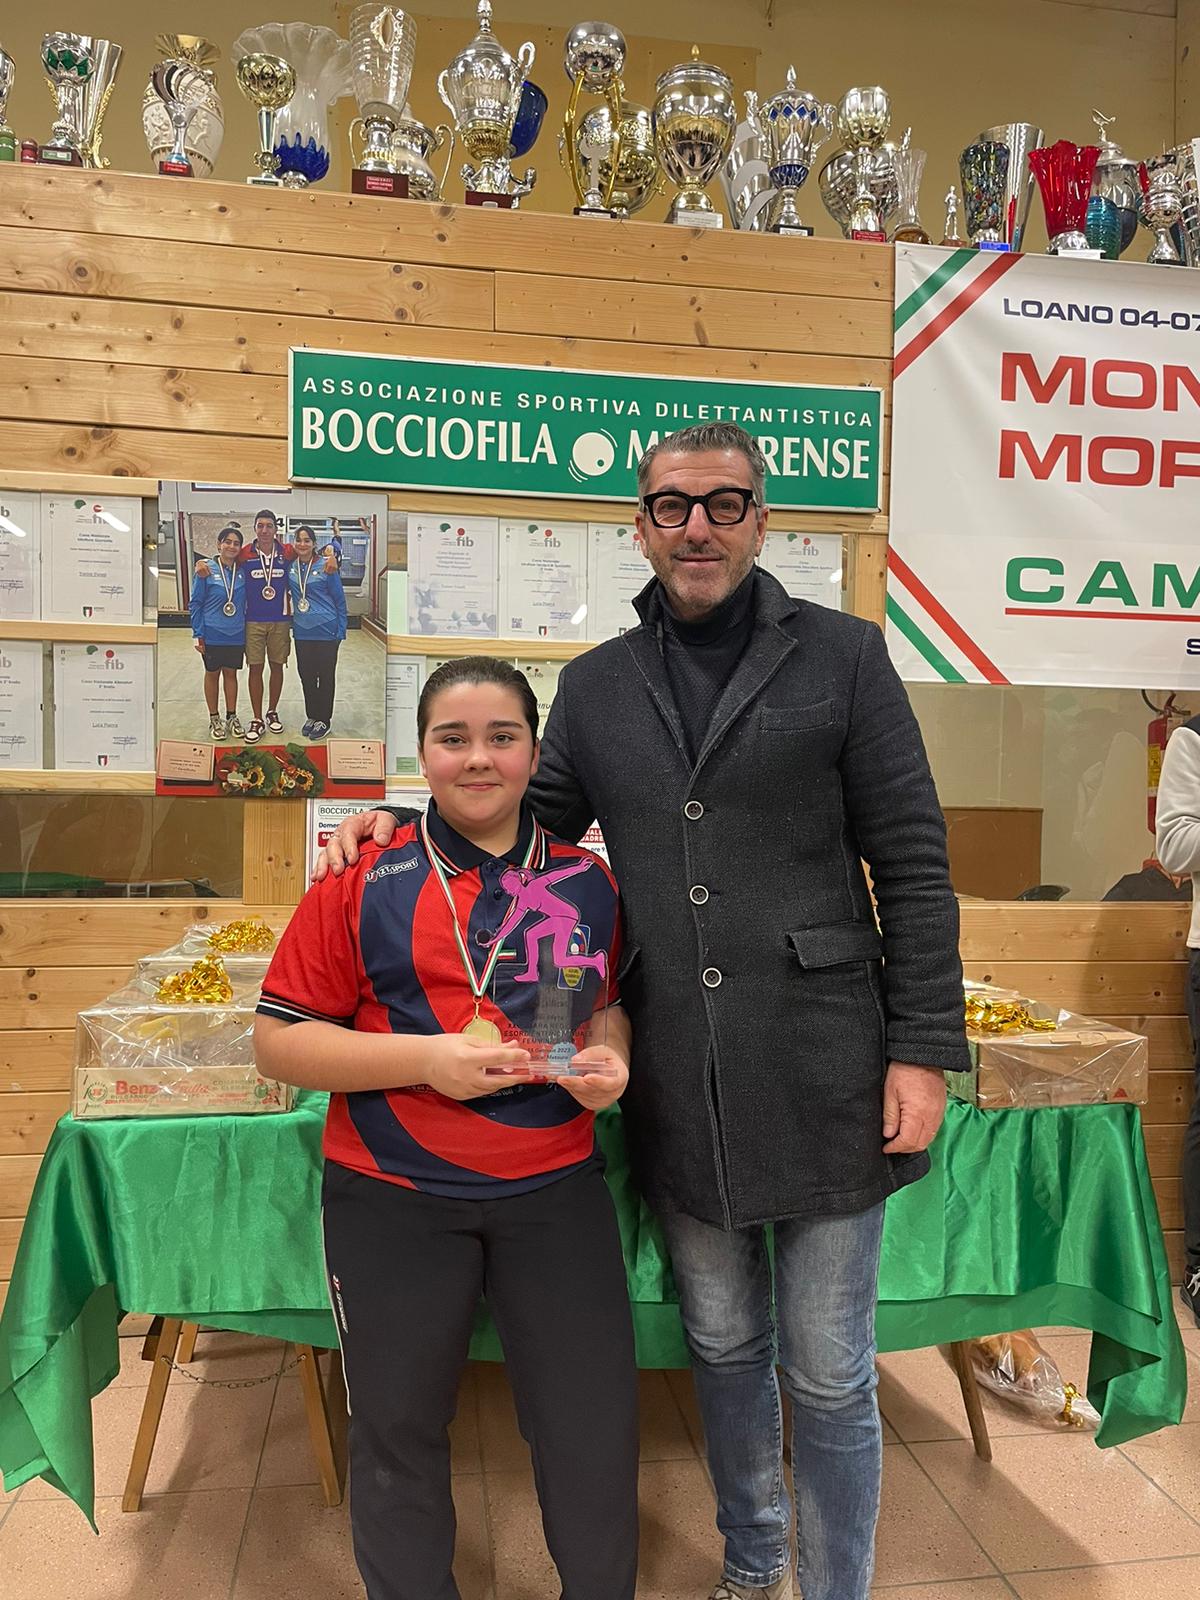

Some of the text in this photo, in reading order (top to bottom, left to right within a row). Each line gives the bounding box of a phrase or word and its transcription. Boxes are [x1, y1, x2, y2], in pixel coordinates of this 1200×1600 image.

[1003, 298, 1114, 324] LOANO
[302, 377, 872, 427] ASSOCIAZIONE SPORTIVA DILETTANTISTICA
[1001, 352, 1200, 412] MON
[302, 407, 558, 465] BOCCIOFILA
[544, 537, 561, 548] fib
[1005, 557, 1200, 608] CAM
[105, 659, 124, 670] fib
